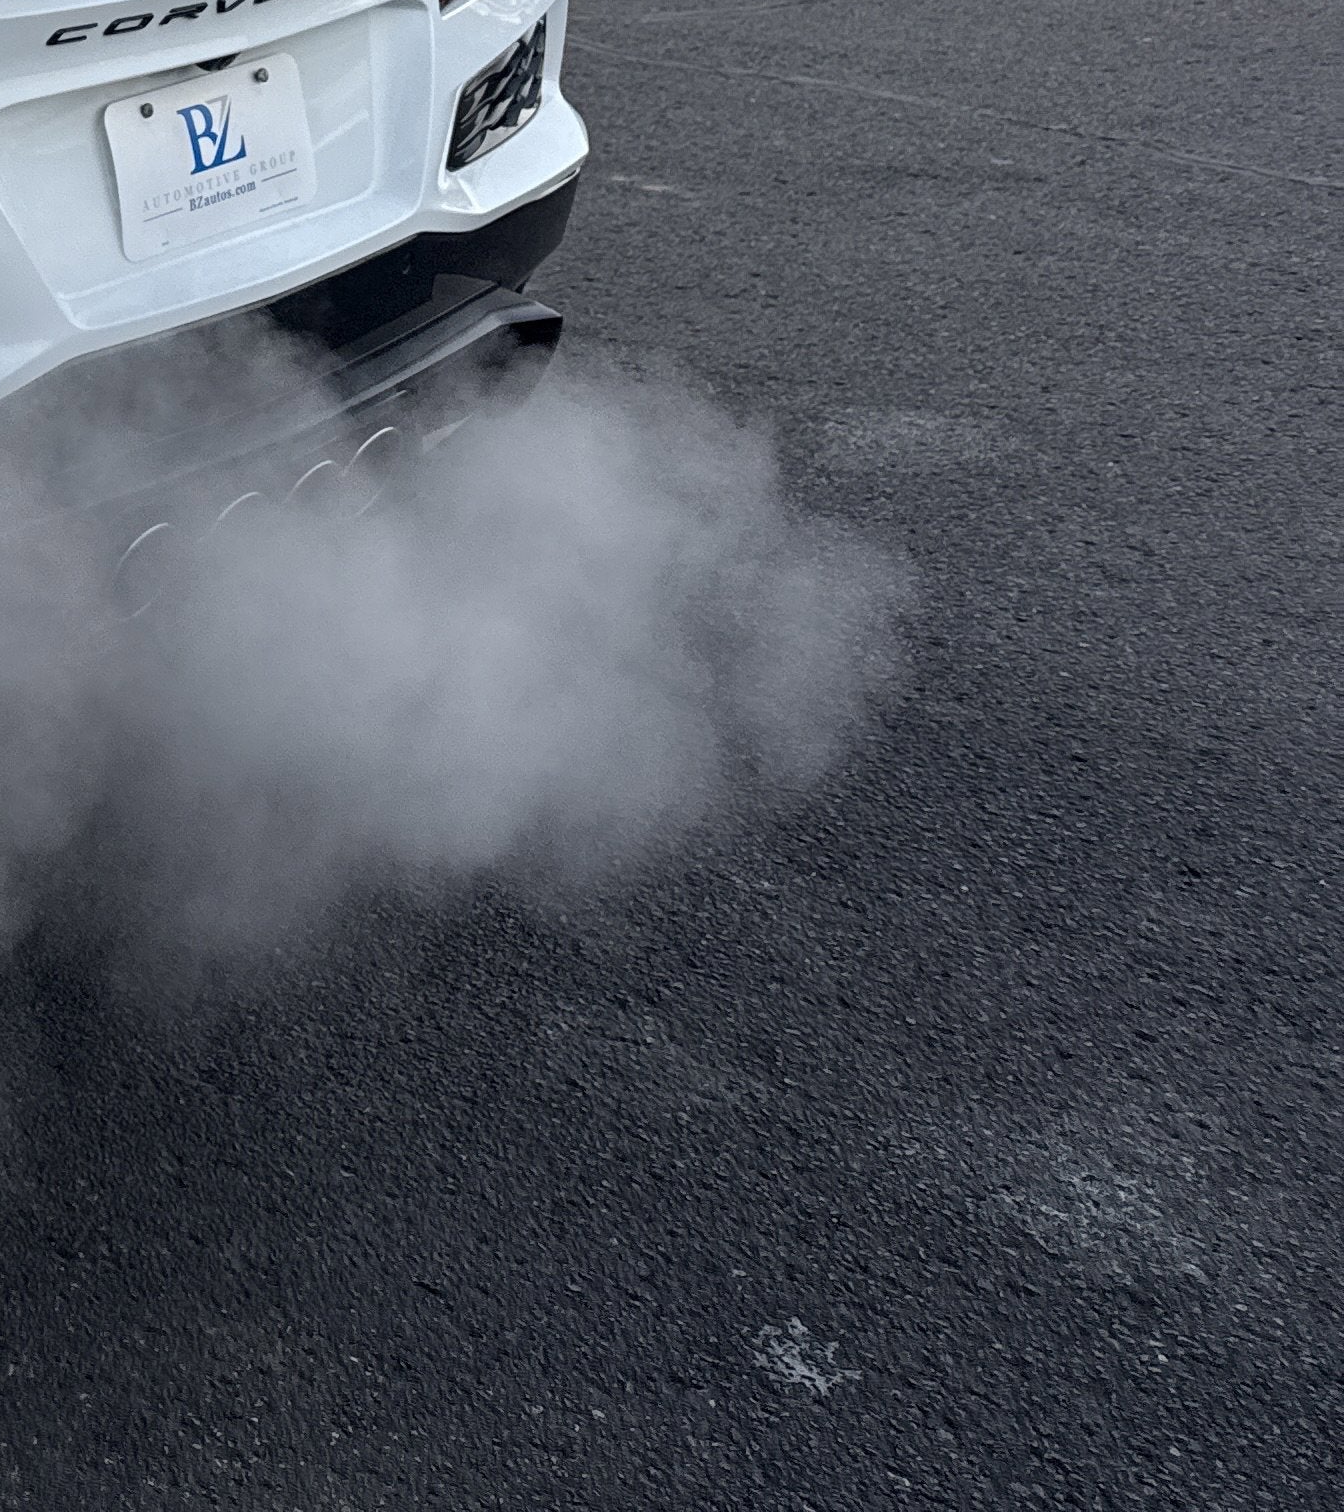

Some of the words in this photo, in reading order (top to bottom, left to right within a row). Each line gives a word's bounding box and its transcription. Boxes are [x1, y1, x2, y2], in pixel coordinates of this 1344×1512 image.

[176, 94, 247, 175] BZ
[142, 170, 241, 213] AUTOMOTIVE
[249, 149, 297, 176] GROUP
[188, 180, 257, 212] BZautos.com
